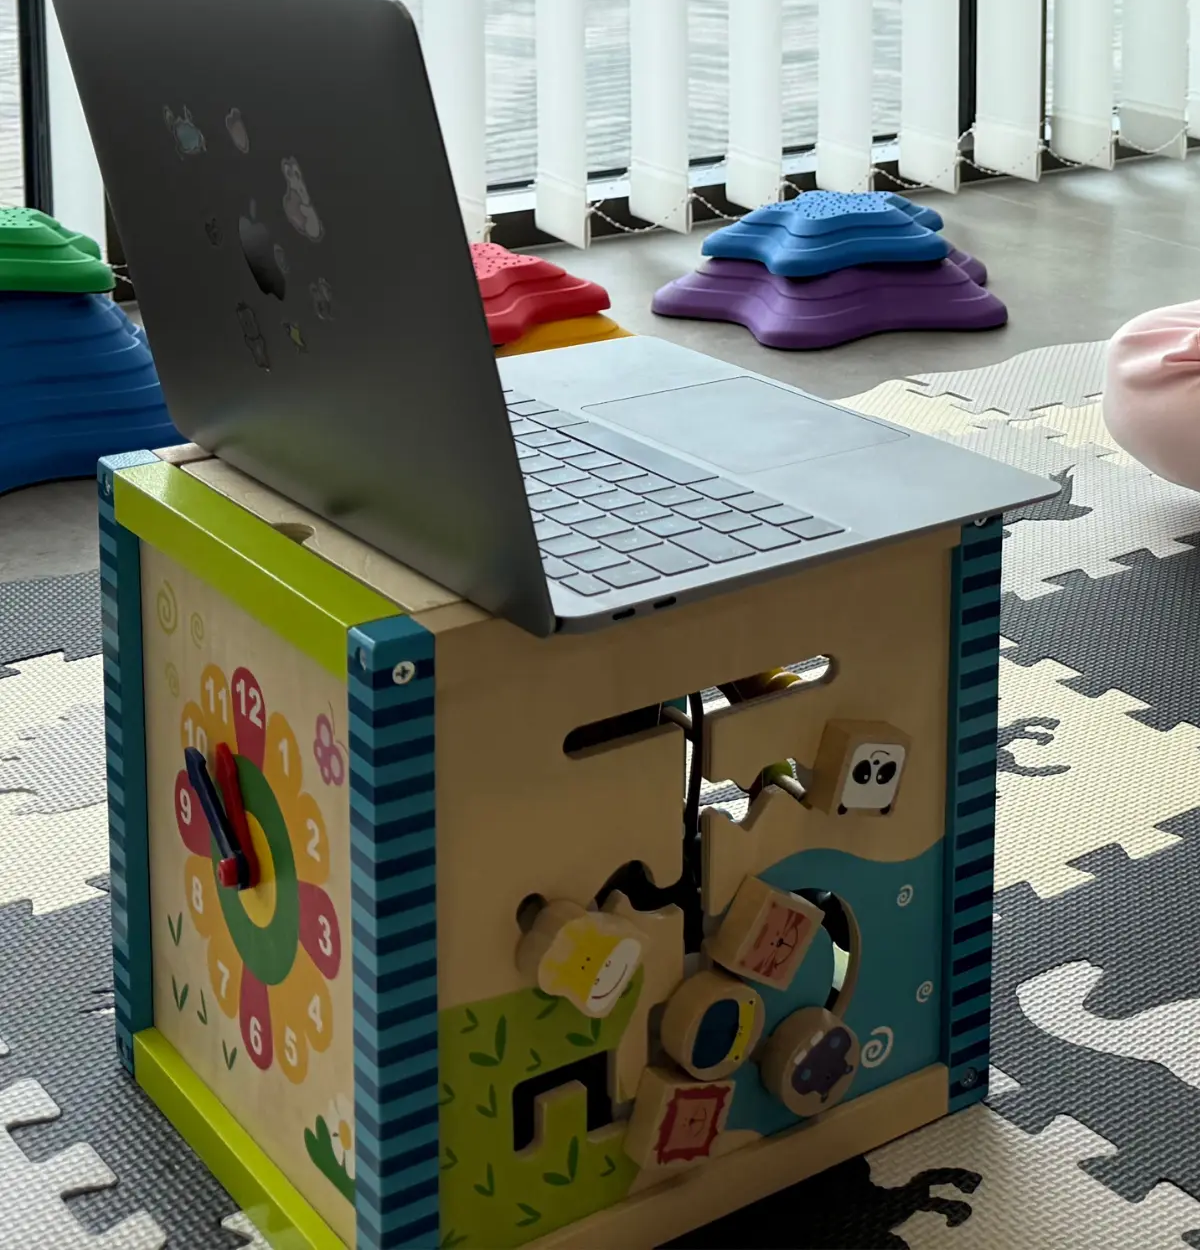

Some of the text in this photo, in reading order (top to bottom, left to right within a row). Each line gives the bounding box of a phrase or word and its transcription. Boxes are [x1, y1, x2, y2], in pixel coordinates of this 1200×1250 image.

[205, 675, 228, 725] 11
[236, 678, 263, 729] 12
[184, 716, 208, 759] 10
[279, 738, 289, 777] 1
[179, 788, 192, 825] 9
[306, 818, 321, 863] 2
[192, 876, 204, 914] 8
[318, 914, 333, 957] 3
[217, 959, 230, 998] 7
[308, 992, 323, 1033] 4
[249, 1015, 263, 1056] 6
[284, 1025, 299, 1067] 5
